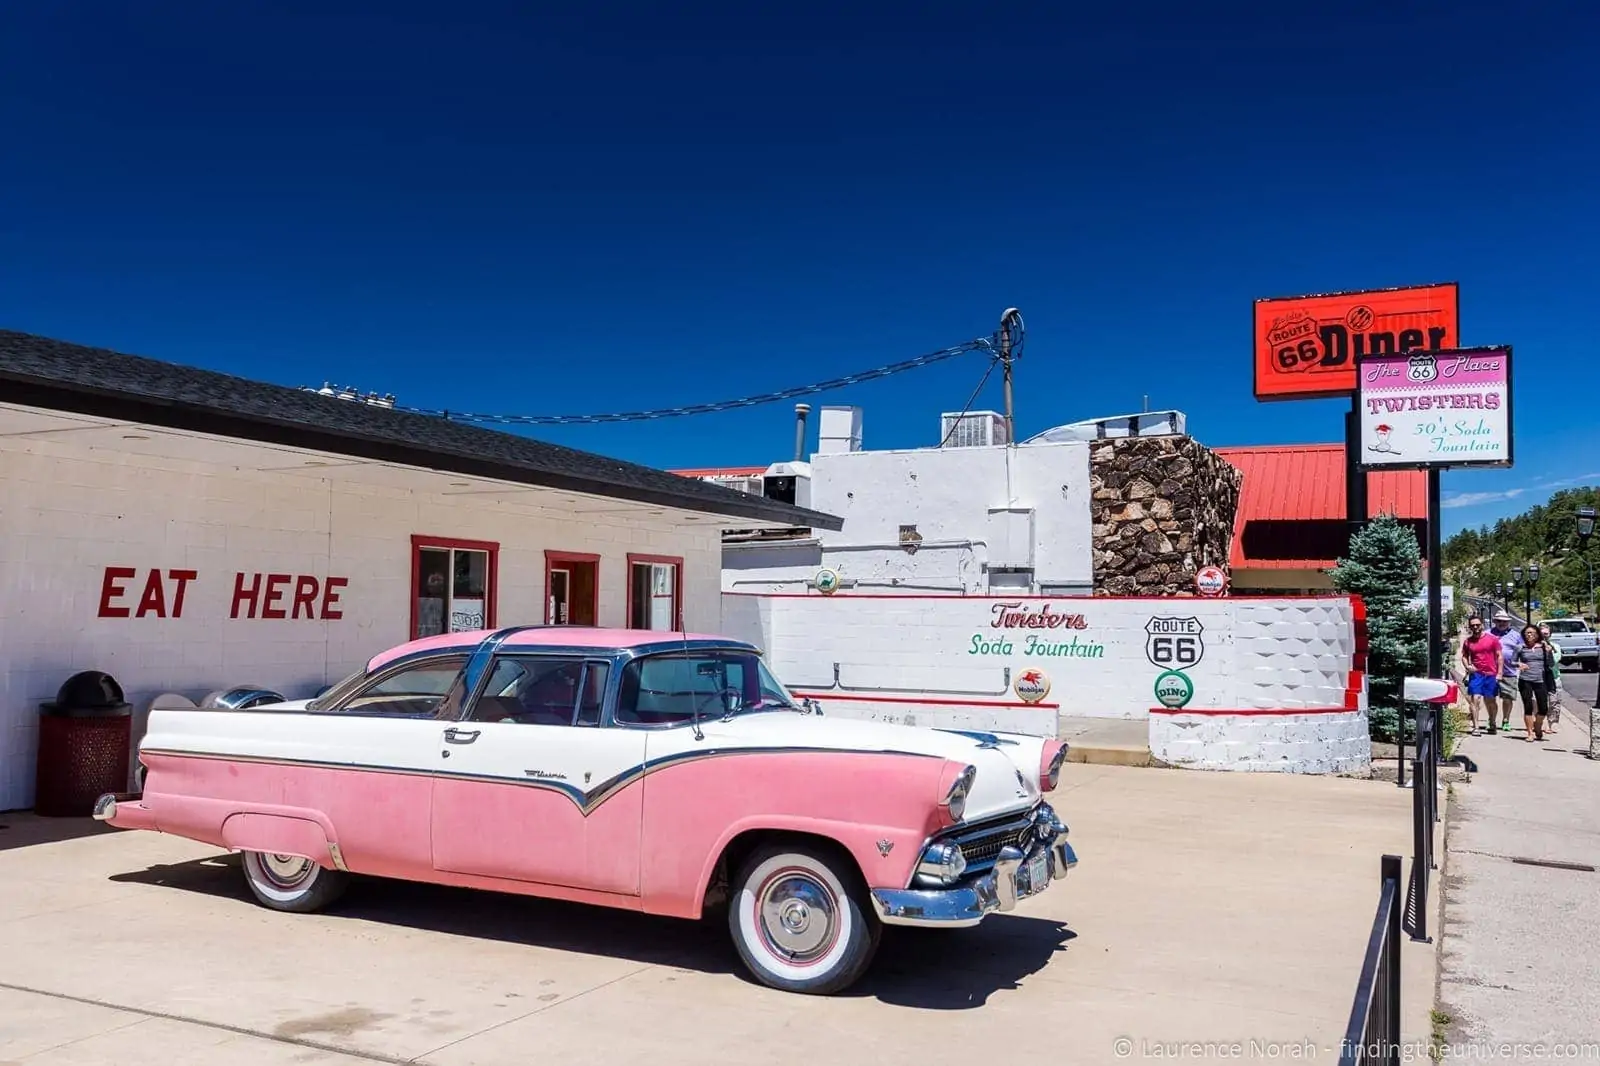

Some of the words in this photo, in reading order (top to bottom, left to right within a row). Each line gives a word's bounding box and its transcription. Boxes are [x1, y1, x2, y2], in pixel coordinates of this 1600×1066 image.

[1274, 324, 1310, 341] ROUTE
[1278, 340, 1318, 368] 66
[1320, 324, 1446, 366] Diner
[1366, 363, 1401, 382] The
[1443, 356, 1501, 377] Place
[1412, 366, 1430, 378] 66
[1367, 392, 1501, 415] TWISTERS
[1412, 417, 1448, 435] 50's
[1449, 419, 1491, 436] Soda
[1428, 438, 1501, 453] Fountain
[98, 567, 197, 618] EAT
[230, 572, 348, 619] HERE
[991, 602, 1088, 630] Twisters
[1153, 620, 1195, 632] ROUTE
[968, 634, 1013, 655] Soda
[1024, 634, 1104, 658] Fountain
[1153, 638, 1196, 663] 66
[1018, 686, 1044, 694] Mobilgas
[1159, 687, 1187, 697] DINO
